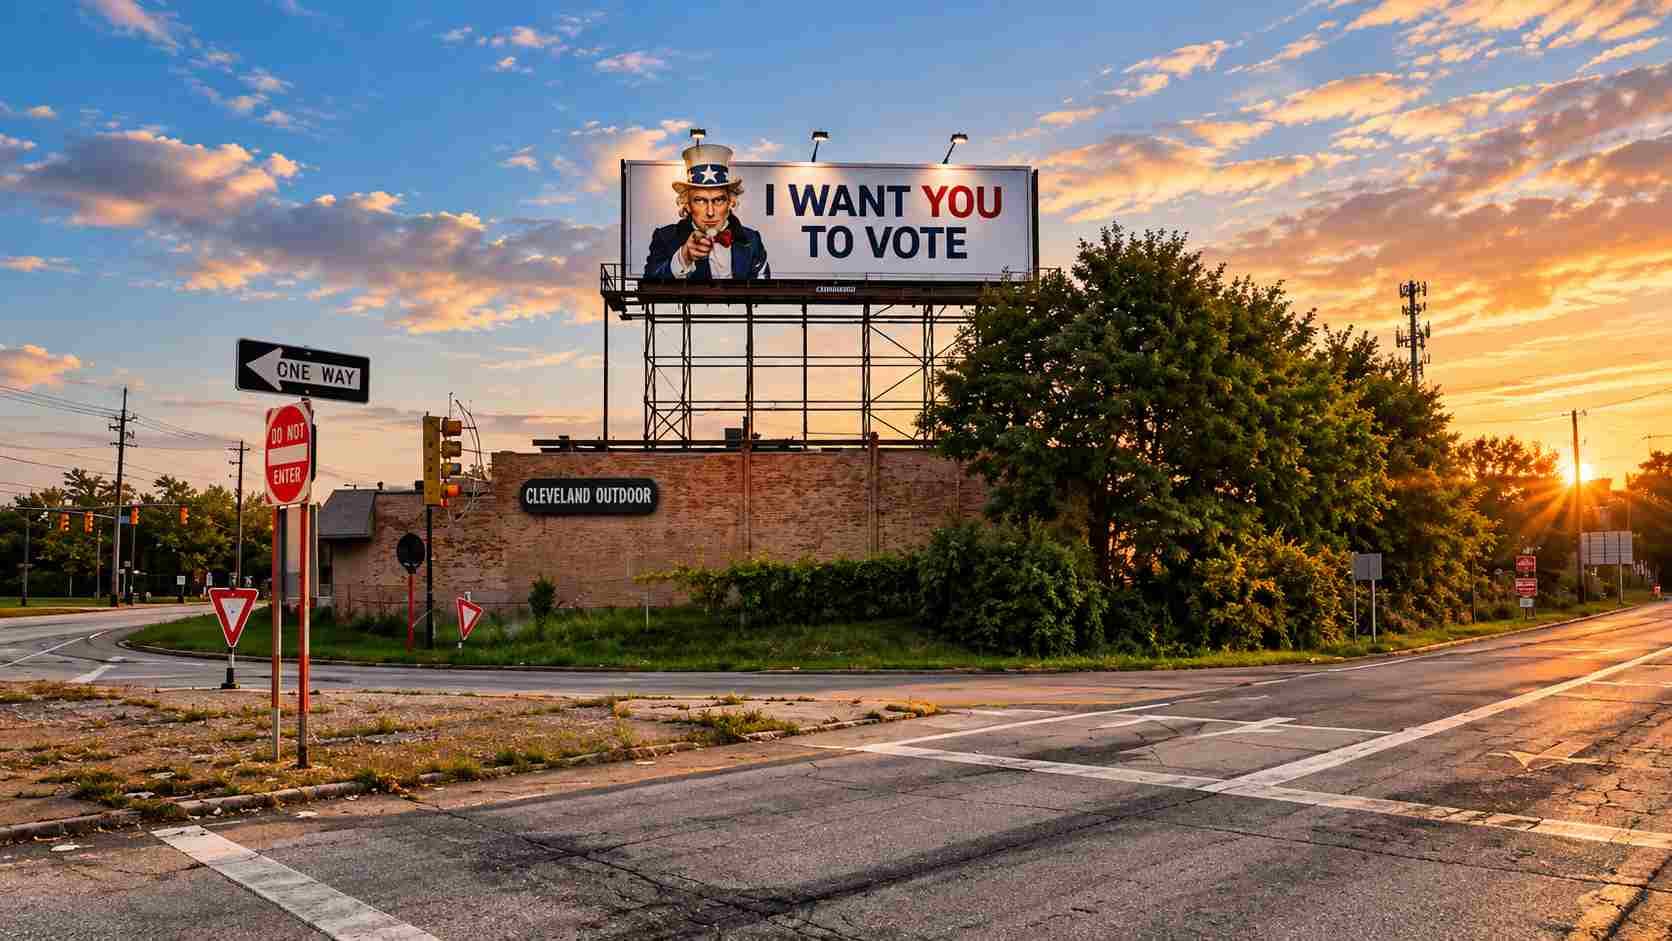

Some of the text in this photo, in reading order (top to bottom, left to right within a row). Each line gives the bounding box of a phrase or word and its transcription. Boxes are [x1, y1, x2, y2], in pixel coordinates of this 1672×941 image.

[765, 183, 1002, 219] I WANT YOU
[801, 225, 968, 259] TO VOTE
[276, 361, 355, 385] ONE WAY
[271, 423, 305, 444] DO NOT
[273, 467, 301, 485] ENTER
[526, 487, 652, 504] CLEVELAND OUTDOOR
